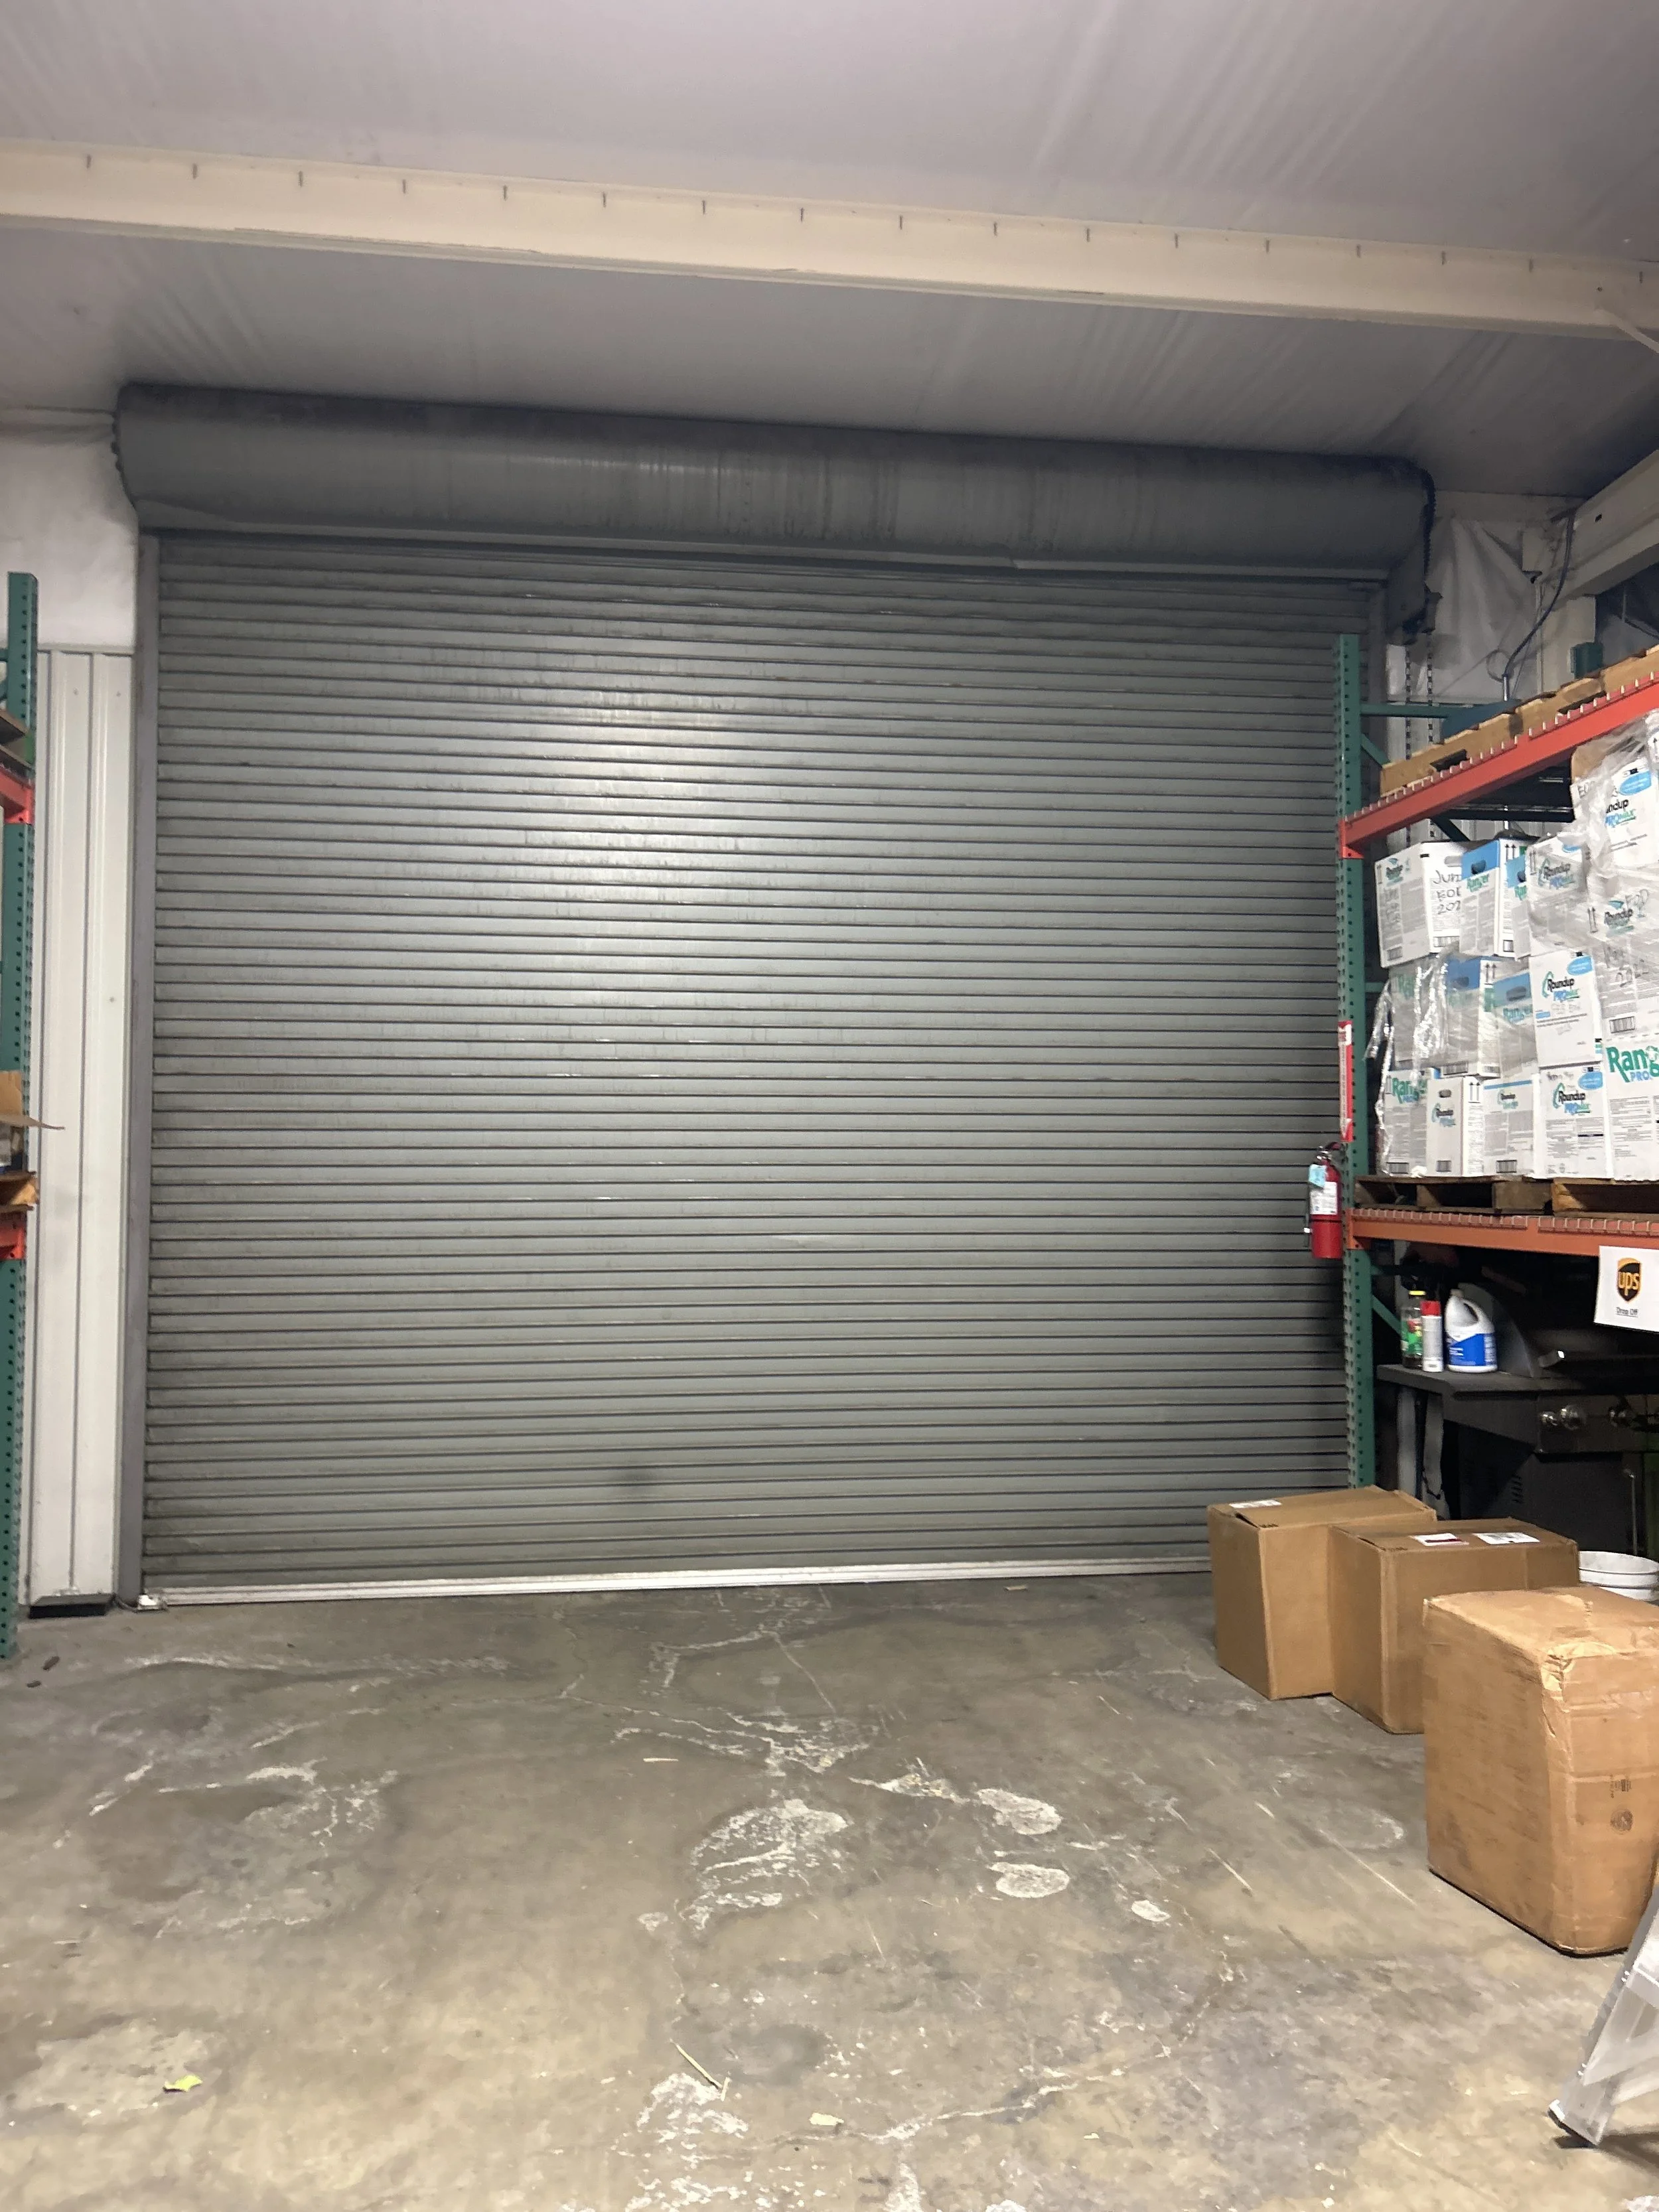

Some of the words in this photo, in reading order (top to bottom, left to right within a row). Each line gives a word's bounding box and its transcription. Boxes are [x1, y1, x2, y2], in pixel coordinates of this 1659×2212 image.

[1547, 976, 1575, 992] Roundup
[1558, 1090, 1585, 1104] Roundup
[1619, 1271, 1640, 1296] ups
